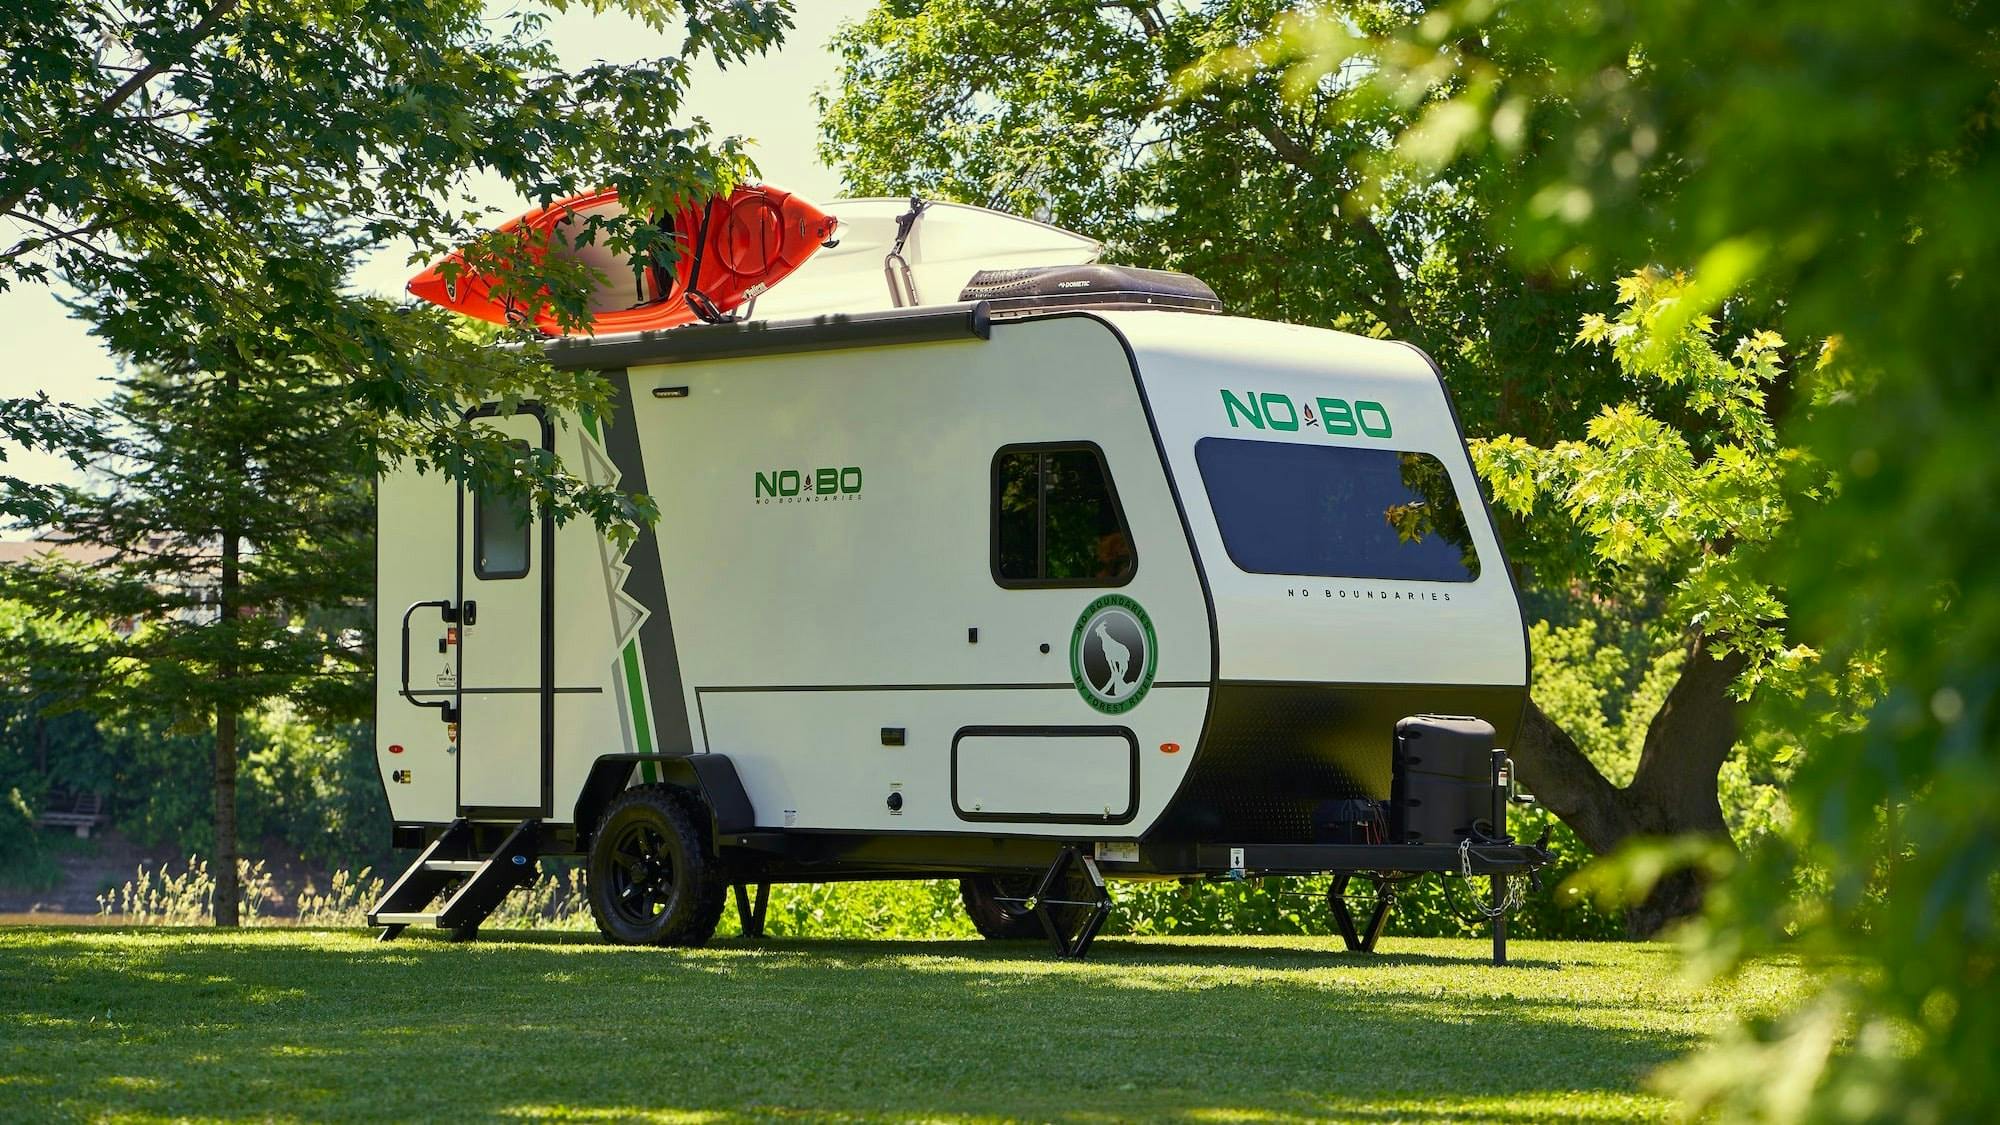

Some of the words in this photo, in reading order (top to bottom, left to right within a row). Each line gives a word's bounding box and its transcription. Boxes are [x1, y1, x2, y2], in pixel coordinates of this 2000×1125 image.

[1065, 280, 1090, 288] DOMETIC
[779, 495, 862, 504] BOUNDARIES
[1288, 589, 1309, 598] NO
[1325, 589, 1451, 601] BOUNDARIES
[1076, 616, 1088, 632] NO
[1090, 597, 1153, 630] BOUNDARIES
[1088, 695, 1125, 712] FOREST
[1130, 673, 1154, 705] RIVER
